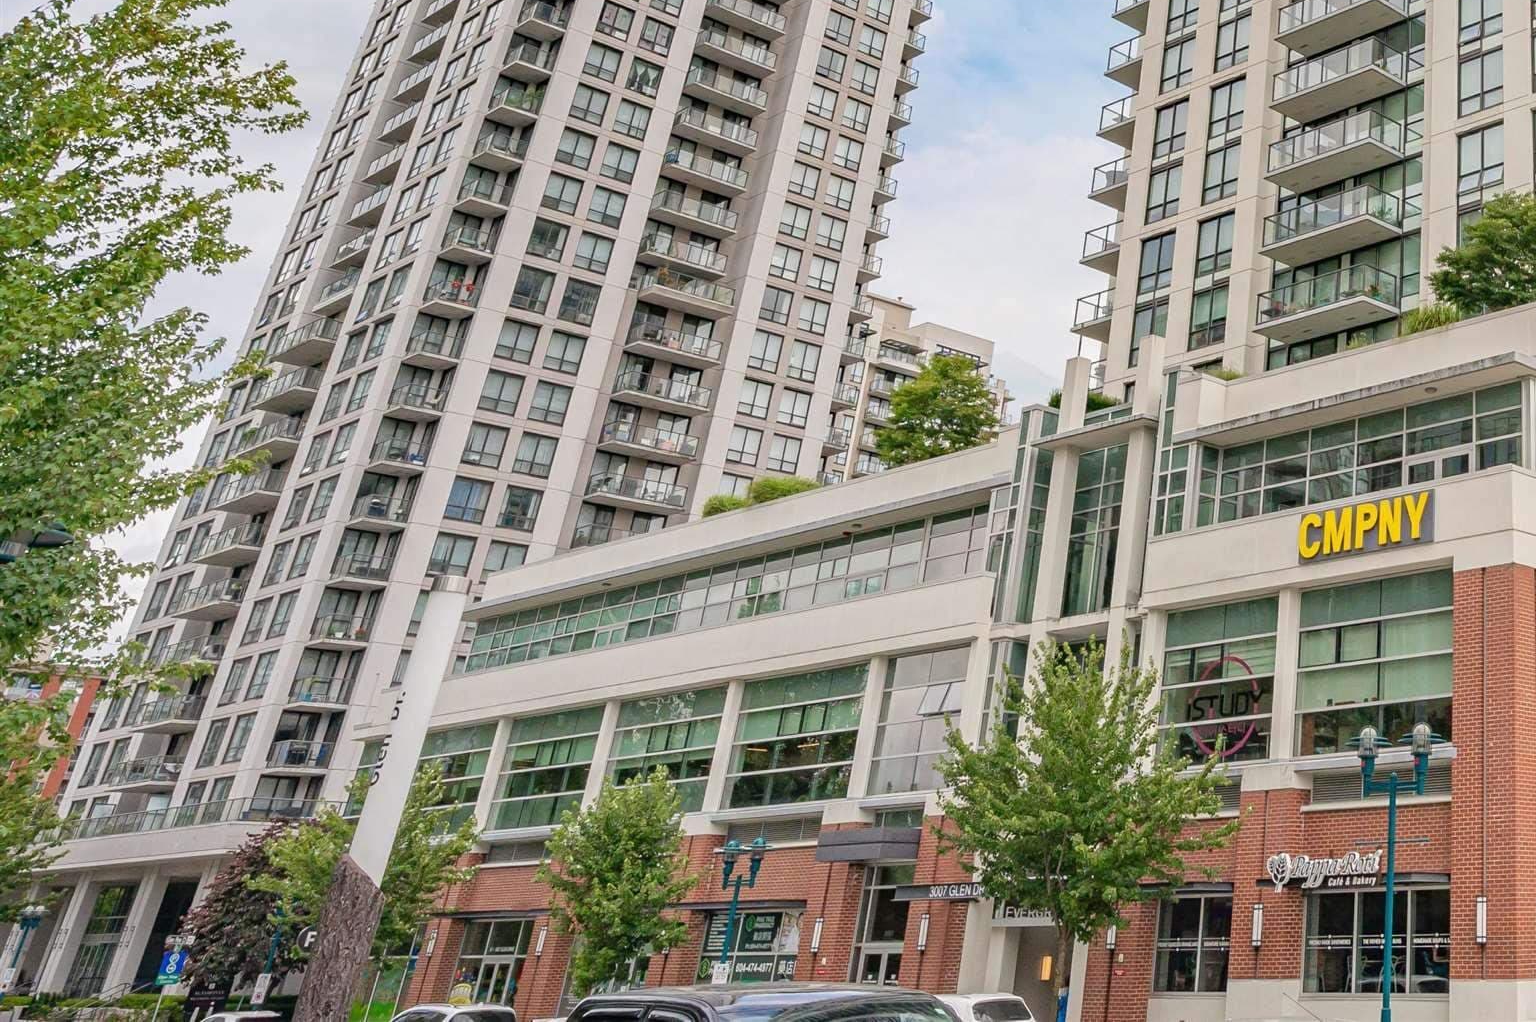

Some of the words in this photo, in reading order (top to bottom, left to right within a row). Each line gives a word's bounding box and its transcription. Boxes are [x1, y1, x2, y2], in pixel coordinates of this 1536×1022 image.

[1298, 491, 1429, 559] CMPNY
[929, 884, 947, 898] 3007
[948, 883, 972, 897] GLEN
